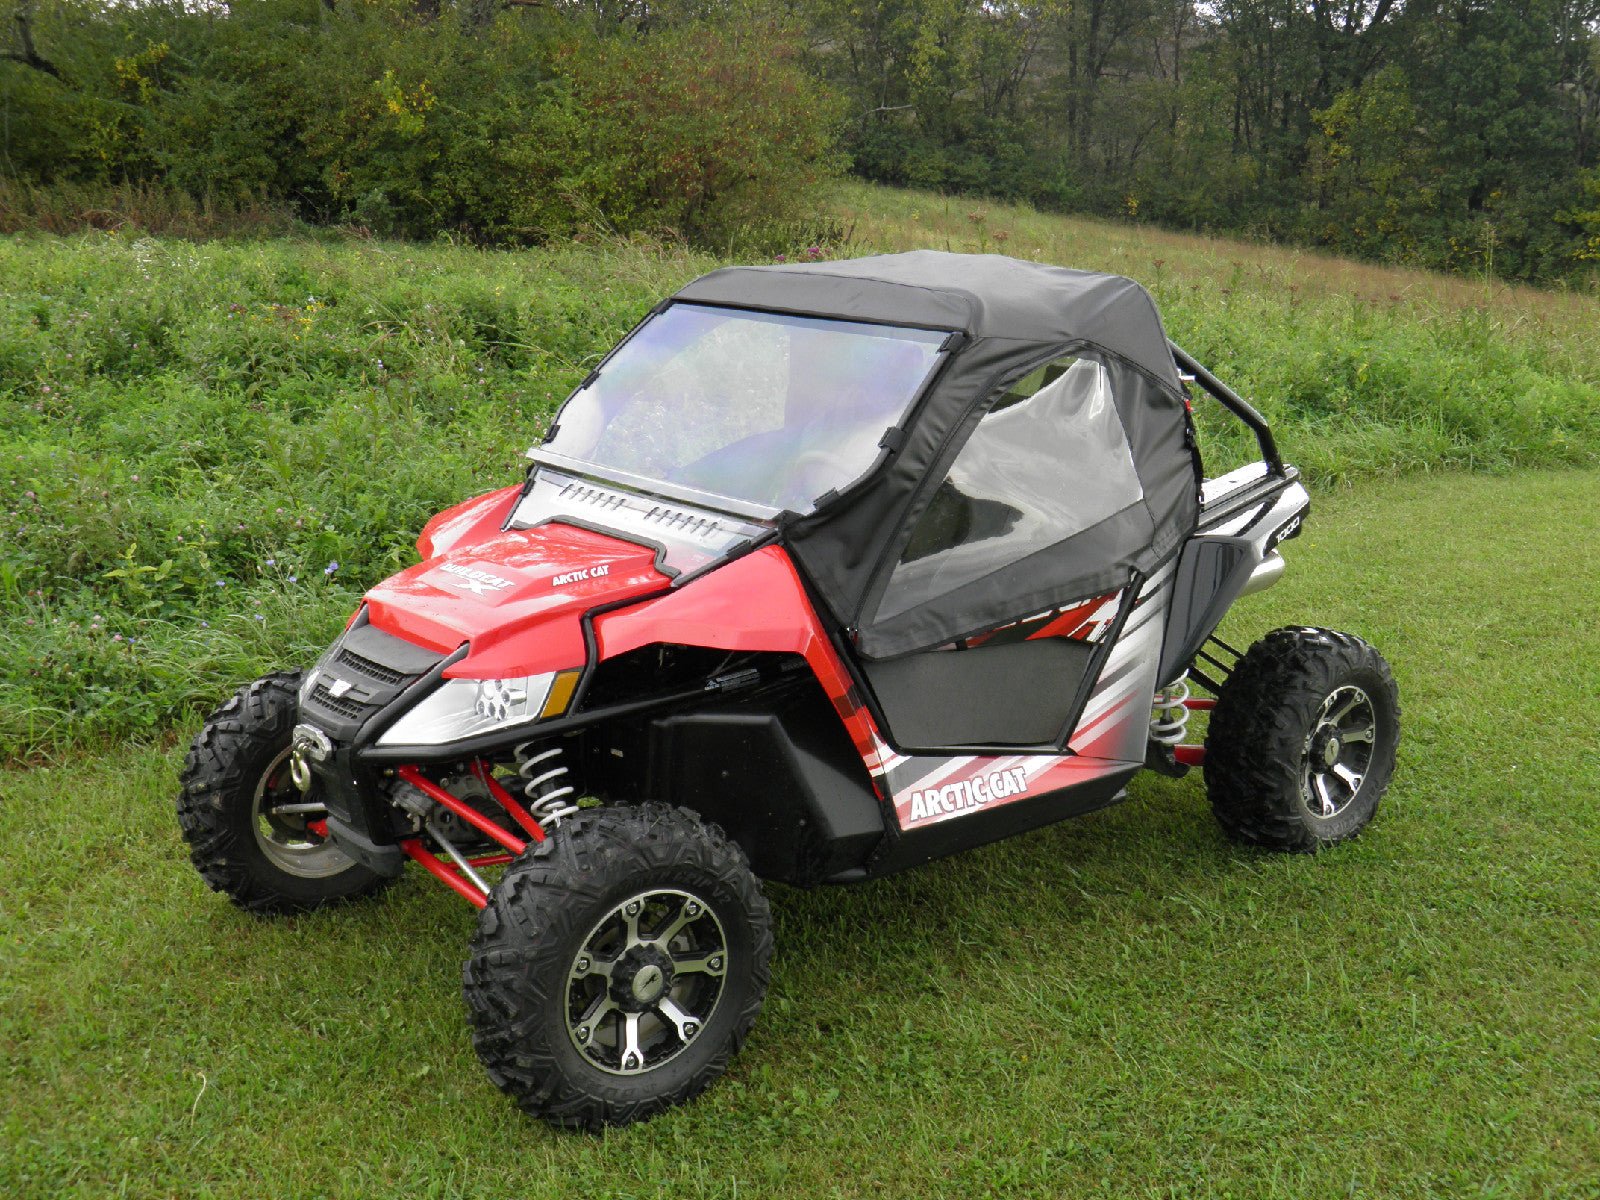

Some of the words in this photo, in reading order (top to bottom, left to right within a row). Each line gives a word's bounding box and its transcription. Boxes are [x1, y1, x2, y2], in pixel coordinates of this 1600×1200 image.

[552, 569, 588, 587] ARCTIC
[590, 565, 609, 578] CAT
[910, 776, 985, 822] ARCTIC
[988, 766, 1028, 799] CAT
